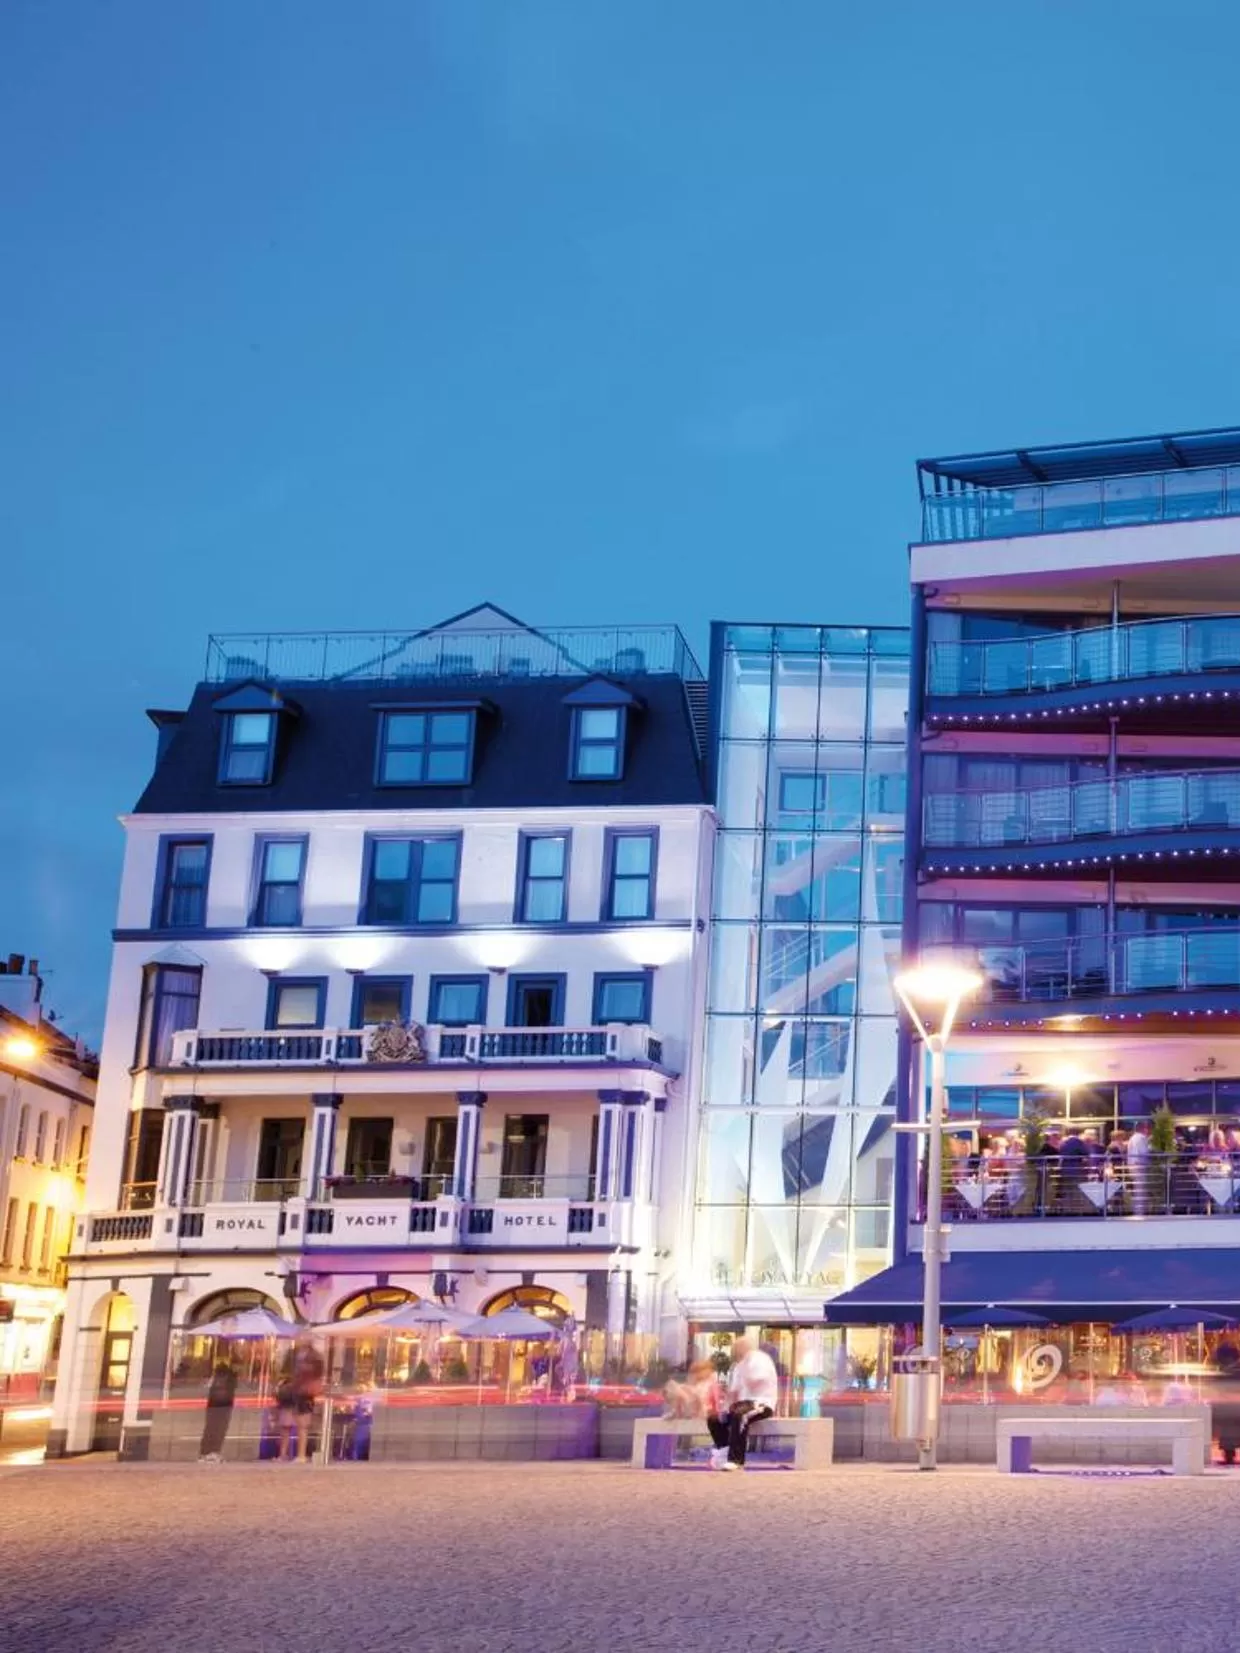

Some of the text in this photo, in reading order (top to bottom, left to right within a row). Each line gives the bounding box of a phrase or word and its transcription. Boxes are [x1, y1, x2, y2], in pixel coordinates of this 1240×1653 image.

[215, 1215, 557, 1230] ROYAL YACHT HOTEL
